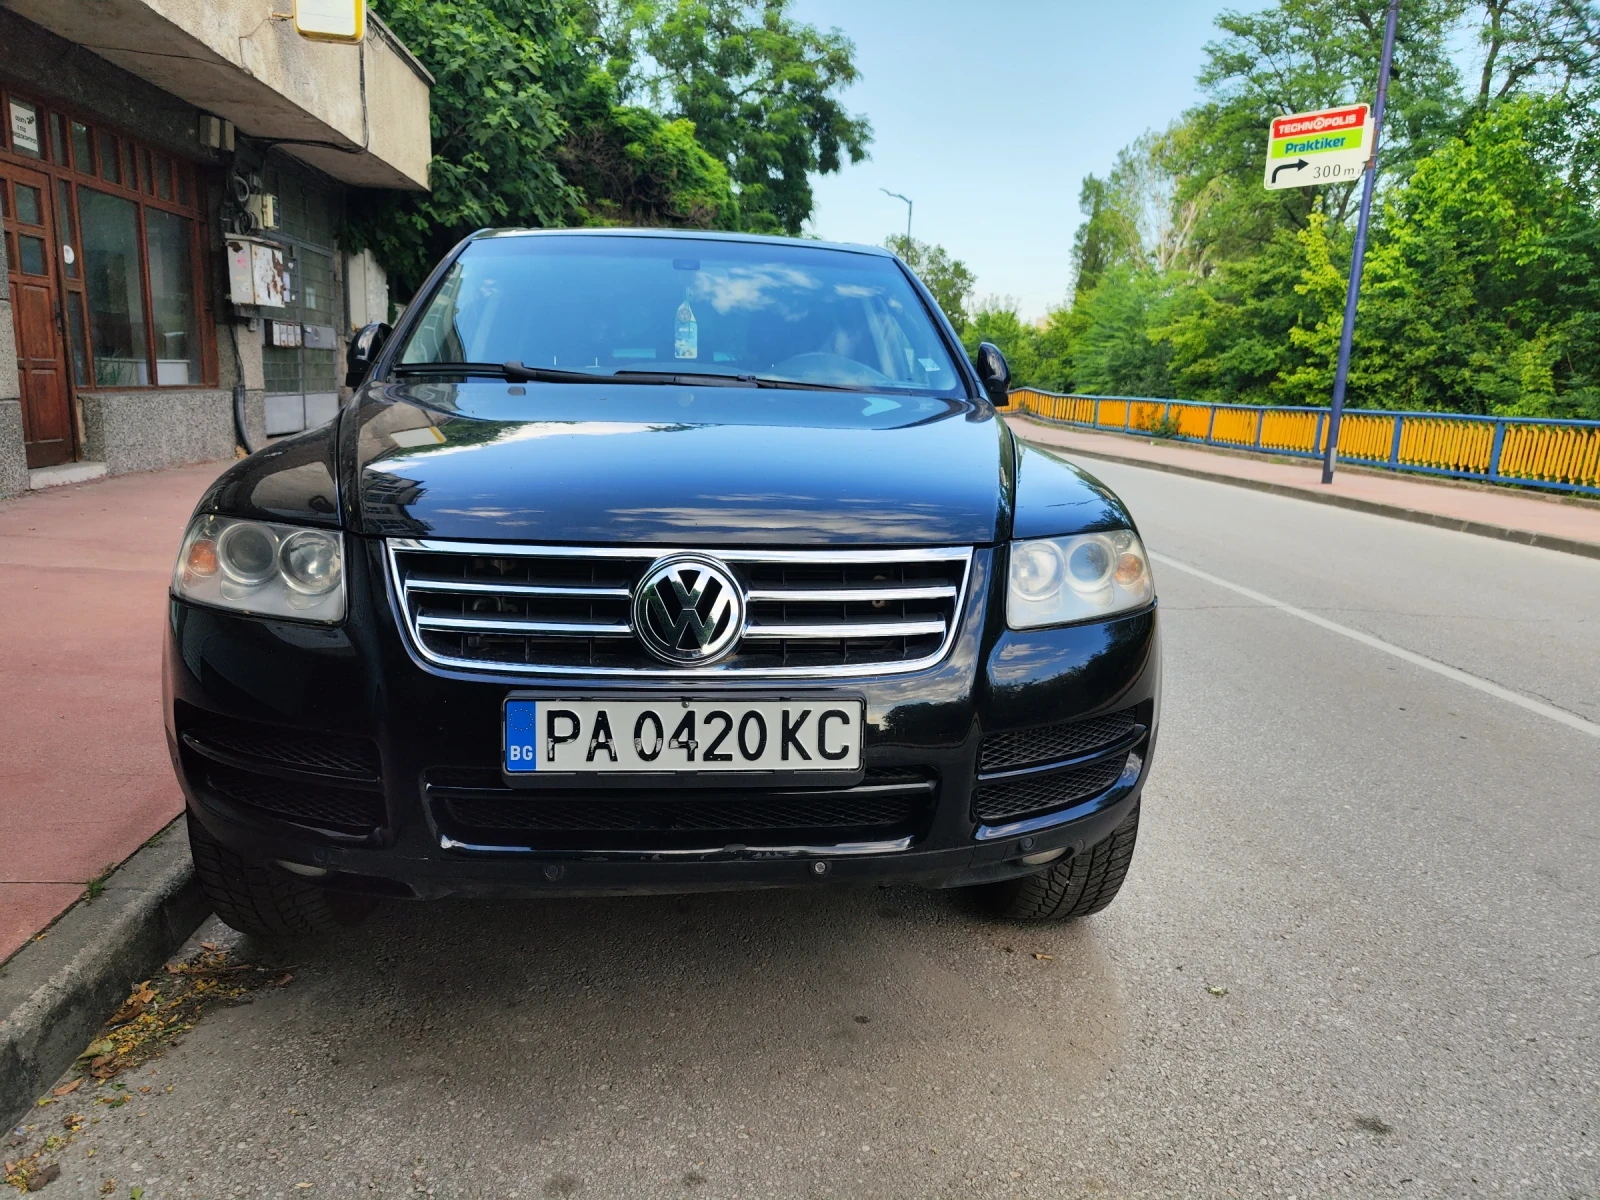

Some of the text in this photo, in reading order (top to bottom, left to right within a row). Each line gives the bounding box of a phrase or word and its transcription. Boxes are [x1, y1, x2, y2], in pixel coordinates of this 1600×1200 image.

[1278, 113, 1356, 134] TECHNOPOLIS
[1285, 137, 1346, 154] Praktiker
[1313, 164, 1355, 179] 300 m
[547, 709, 850, 762] PA 0420 KC
[510, 745, 533, 760] BG
